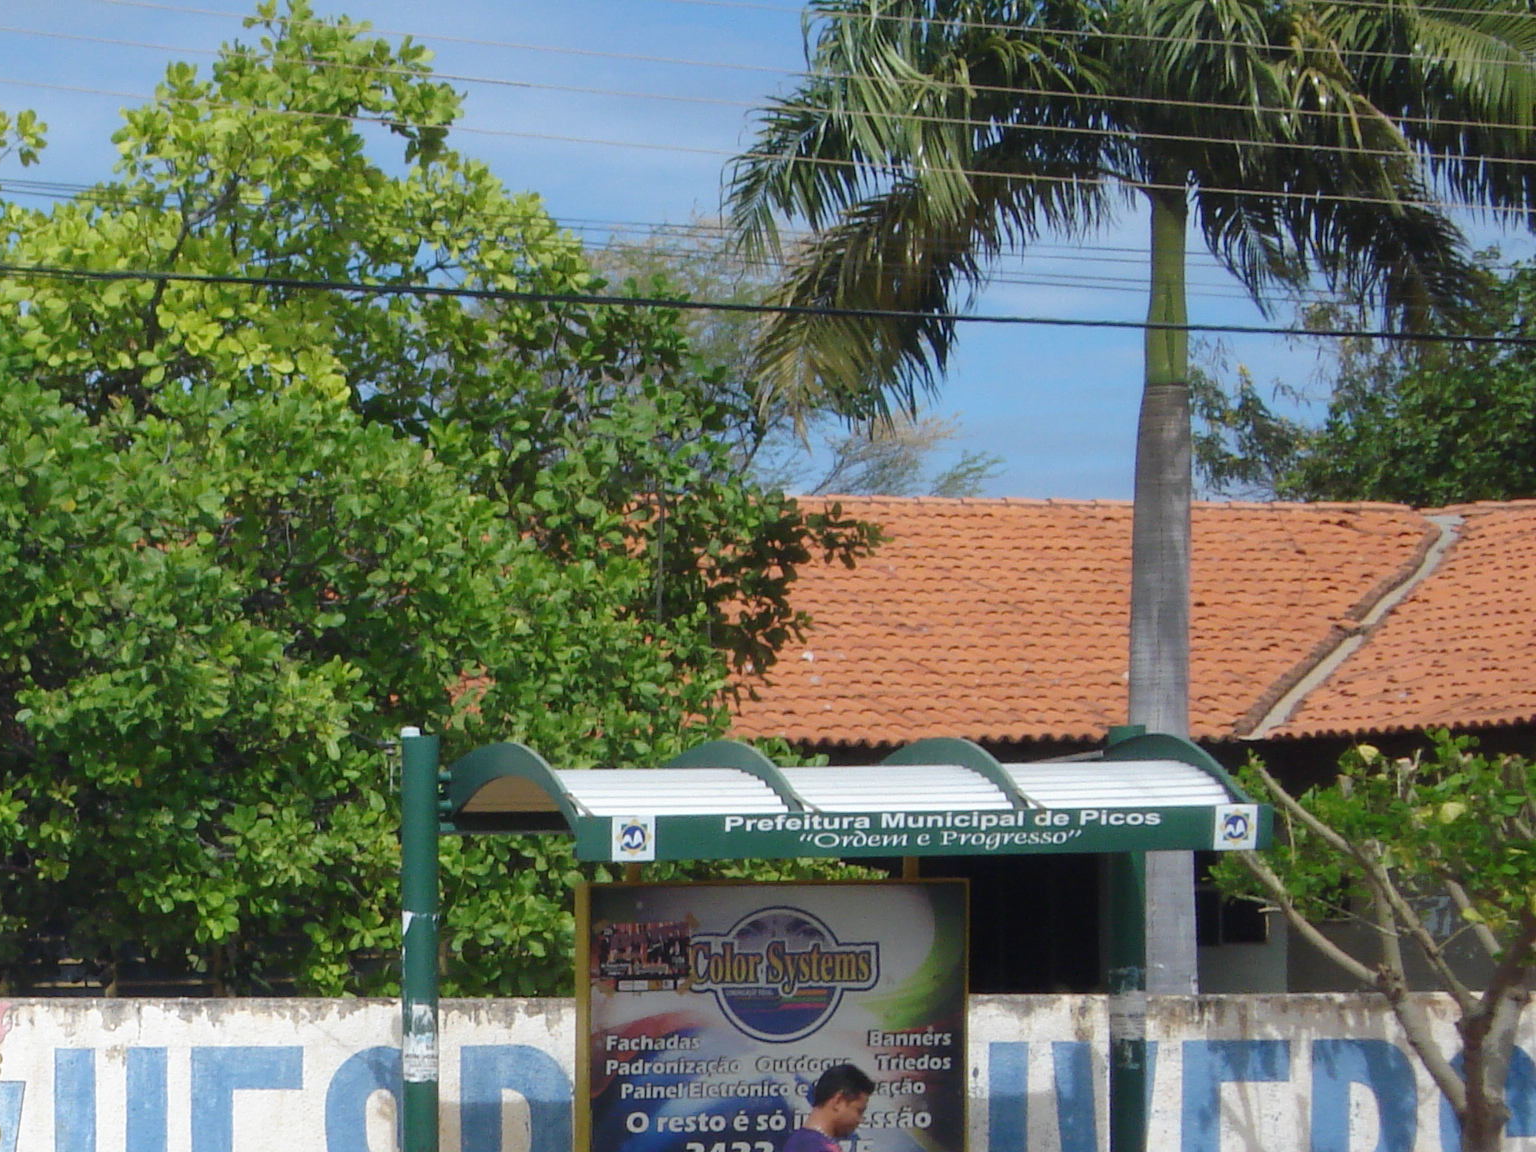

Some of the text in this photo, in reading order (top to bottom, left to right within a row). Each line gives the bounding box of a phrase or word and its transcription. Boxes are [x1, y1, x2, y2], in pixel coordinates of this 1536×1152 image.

[724, 809, 1162, 832] Prefeitura Municipal de Picos
[916, 832, 931, 847] e
[691, 940, 764, 985] Color
[765, 939, 872, 996] Systems
[605, 1030, 953, 1051] Fachadas Banners
[605, 1056, 743, 1076] Padronização
[875, 1053, 952, 1071] Triedos
[620, 1081, 684, 1099] Painel
[687, 1079, 791, 1099] Eletrônico
[796, 1082, 810, 1097] e
[625, 1111, 650, 1134] O
[656, 1112, 727, 1133] resto
[732, 1110, 750, 1132] é
[756, 1109, 787, 1132] só
